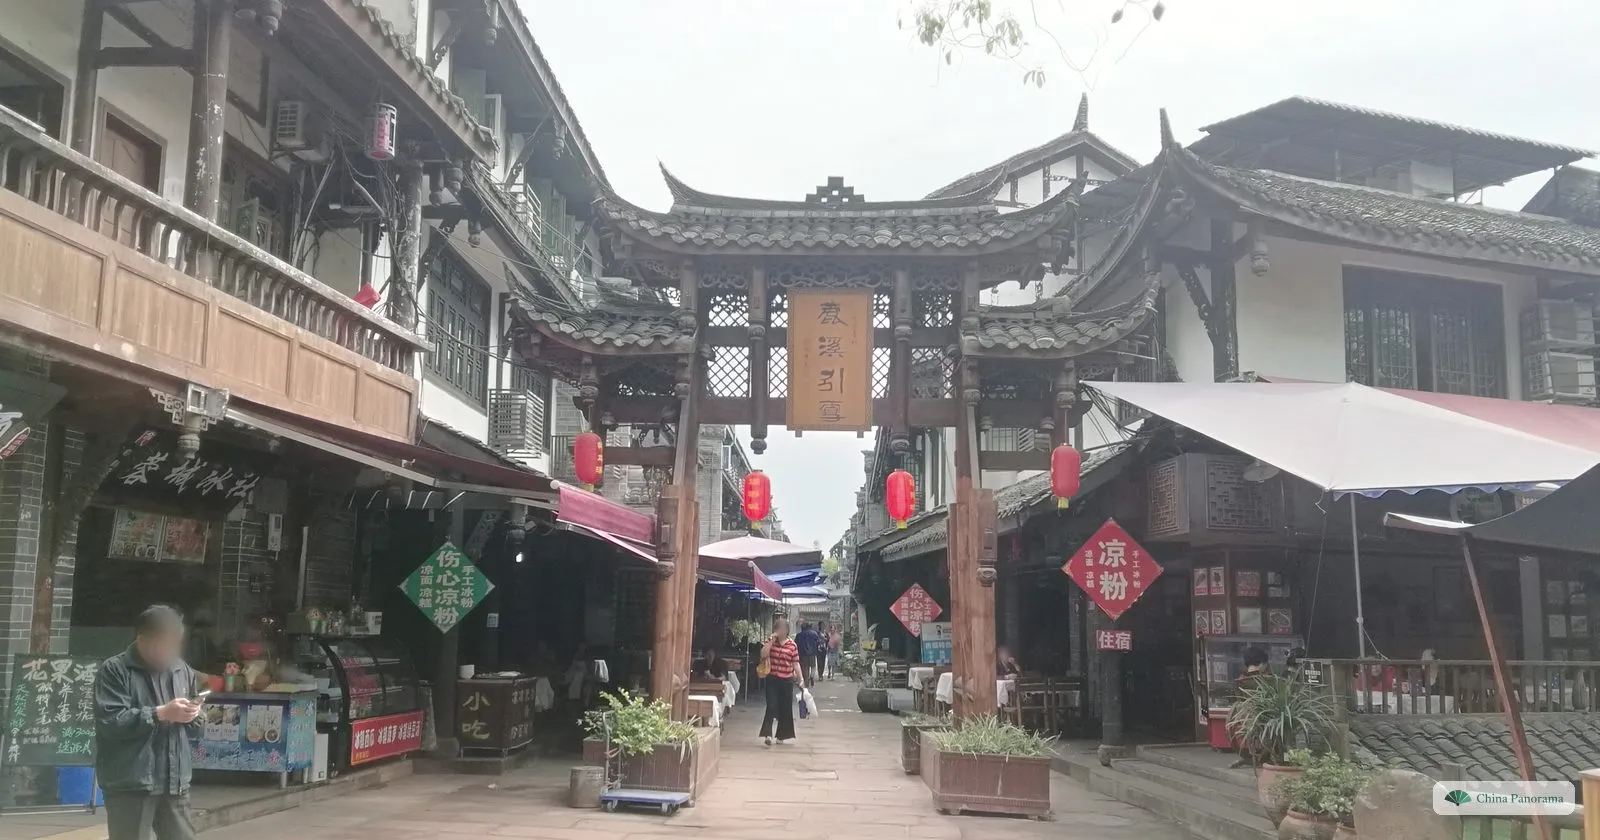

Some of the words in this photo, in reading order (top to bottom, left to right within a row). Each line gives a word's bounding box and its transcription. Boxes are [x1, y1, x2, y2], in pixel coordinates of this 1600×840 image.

[434, 550, 461, 625] 伤心凉粉
[460, 565, 475, 608] 手工冰粉
[1098, 539, 1128, 601] 凉粉
[910, 588, 923, 633] 伤心凉粉
[1099, 631, 1130, 650] 住宿
[462, 691, 491, 740] 小吃
